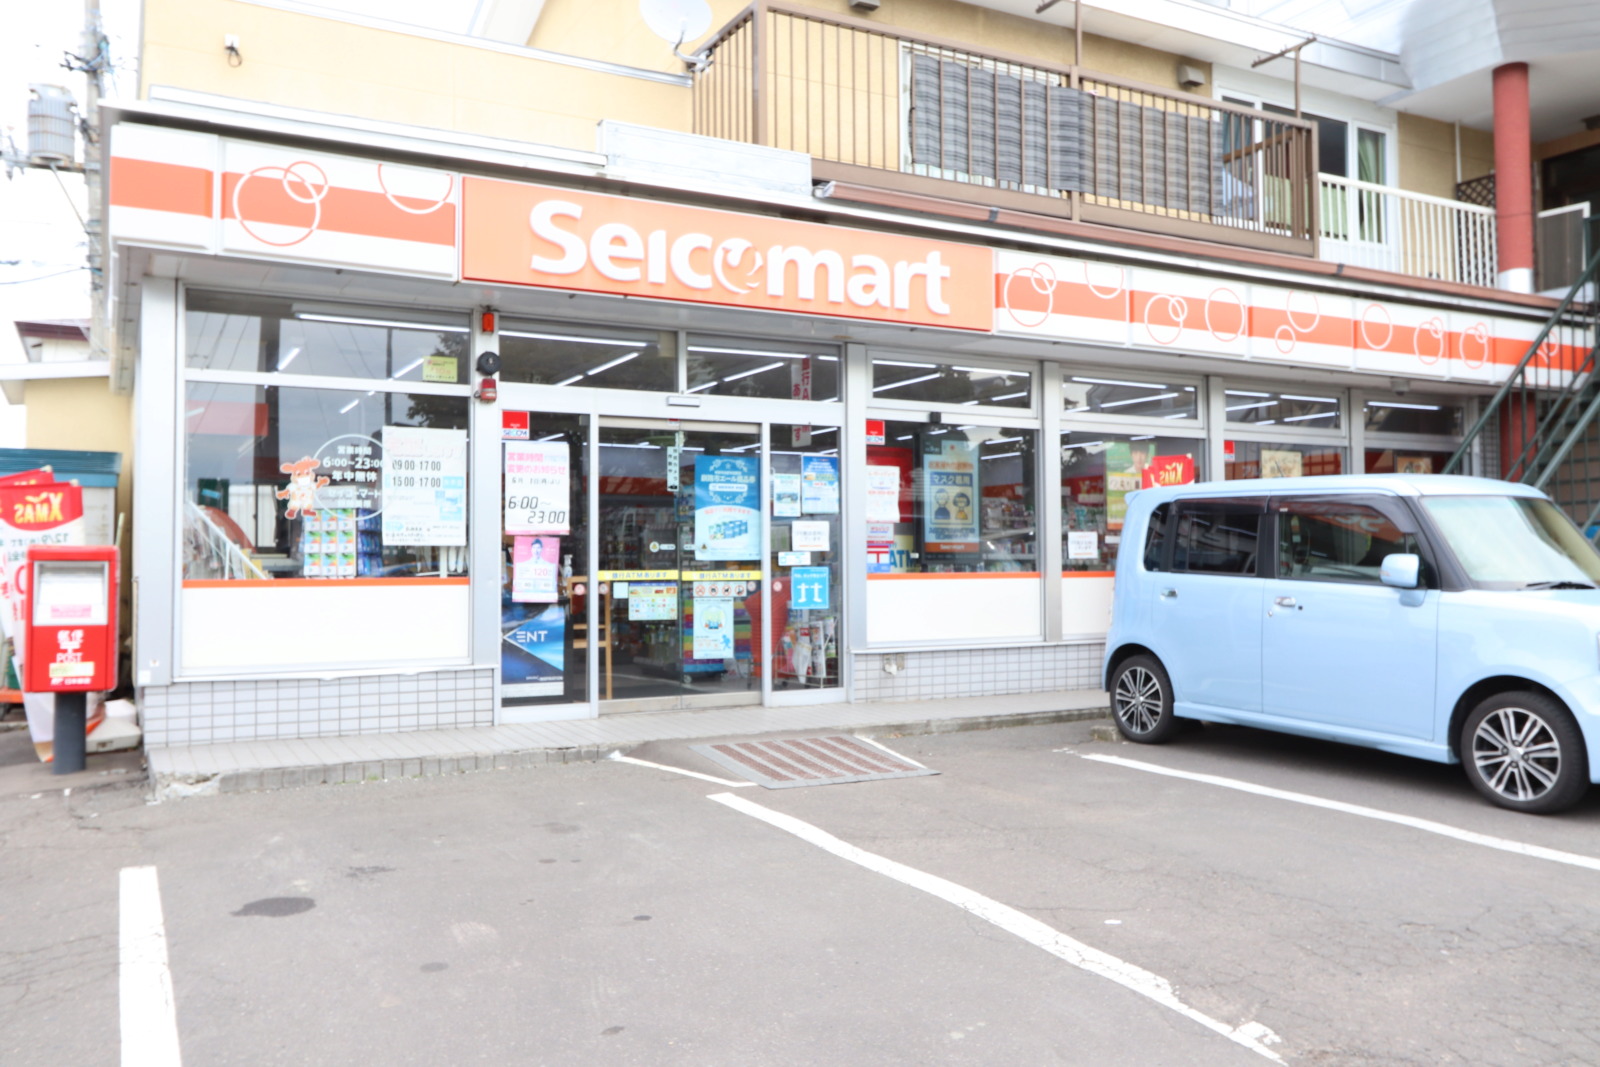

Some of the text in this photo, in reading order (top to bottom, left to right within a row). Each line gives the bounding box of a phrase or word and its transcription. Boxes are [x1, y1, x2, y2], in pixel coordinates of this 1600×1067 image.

[529, 199, 951, 315] Seicomart
[332, 470, 377, 482] 年中無休
